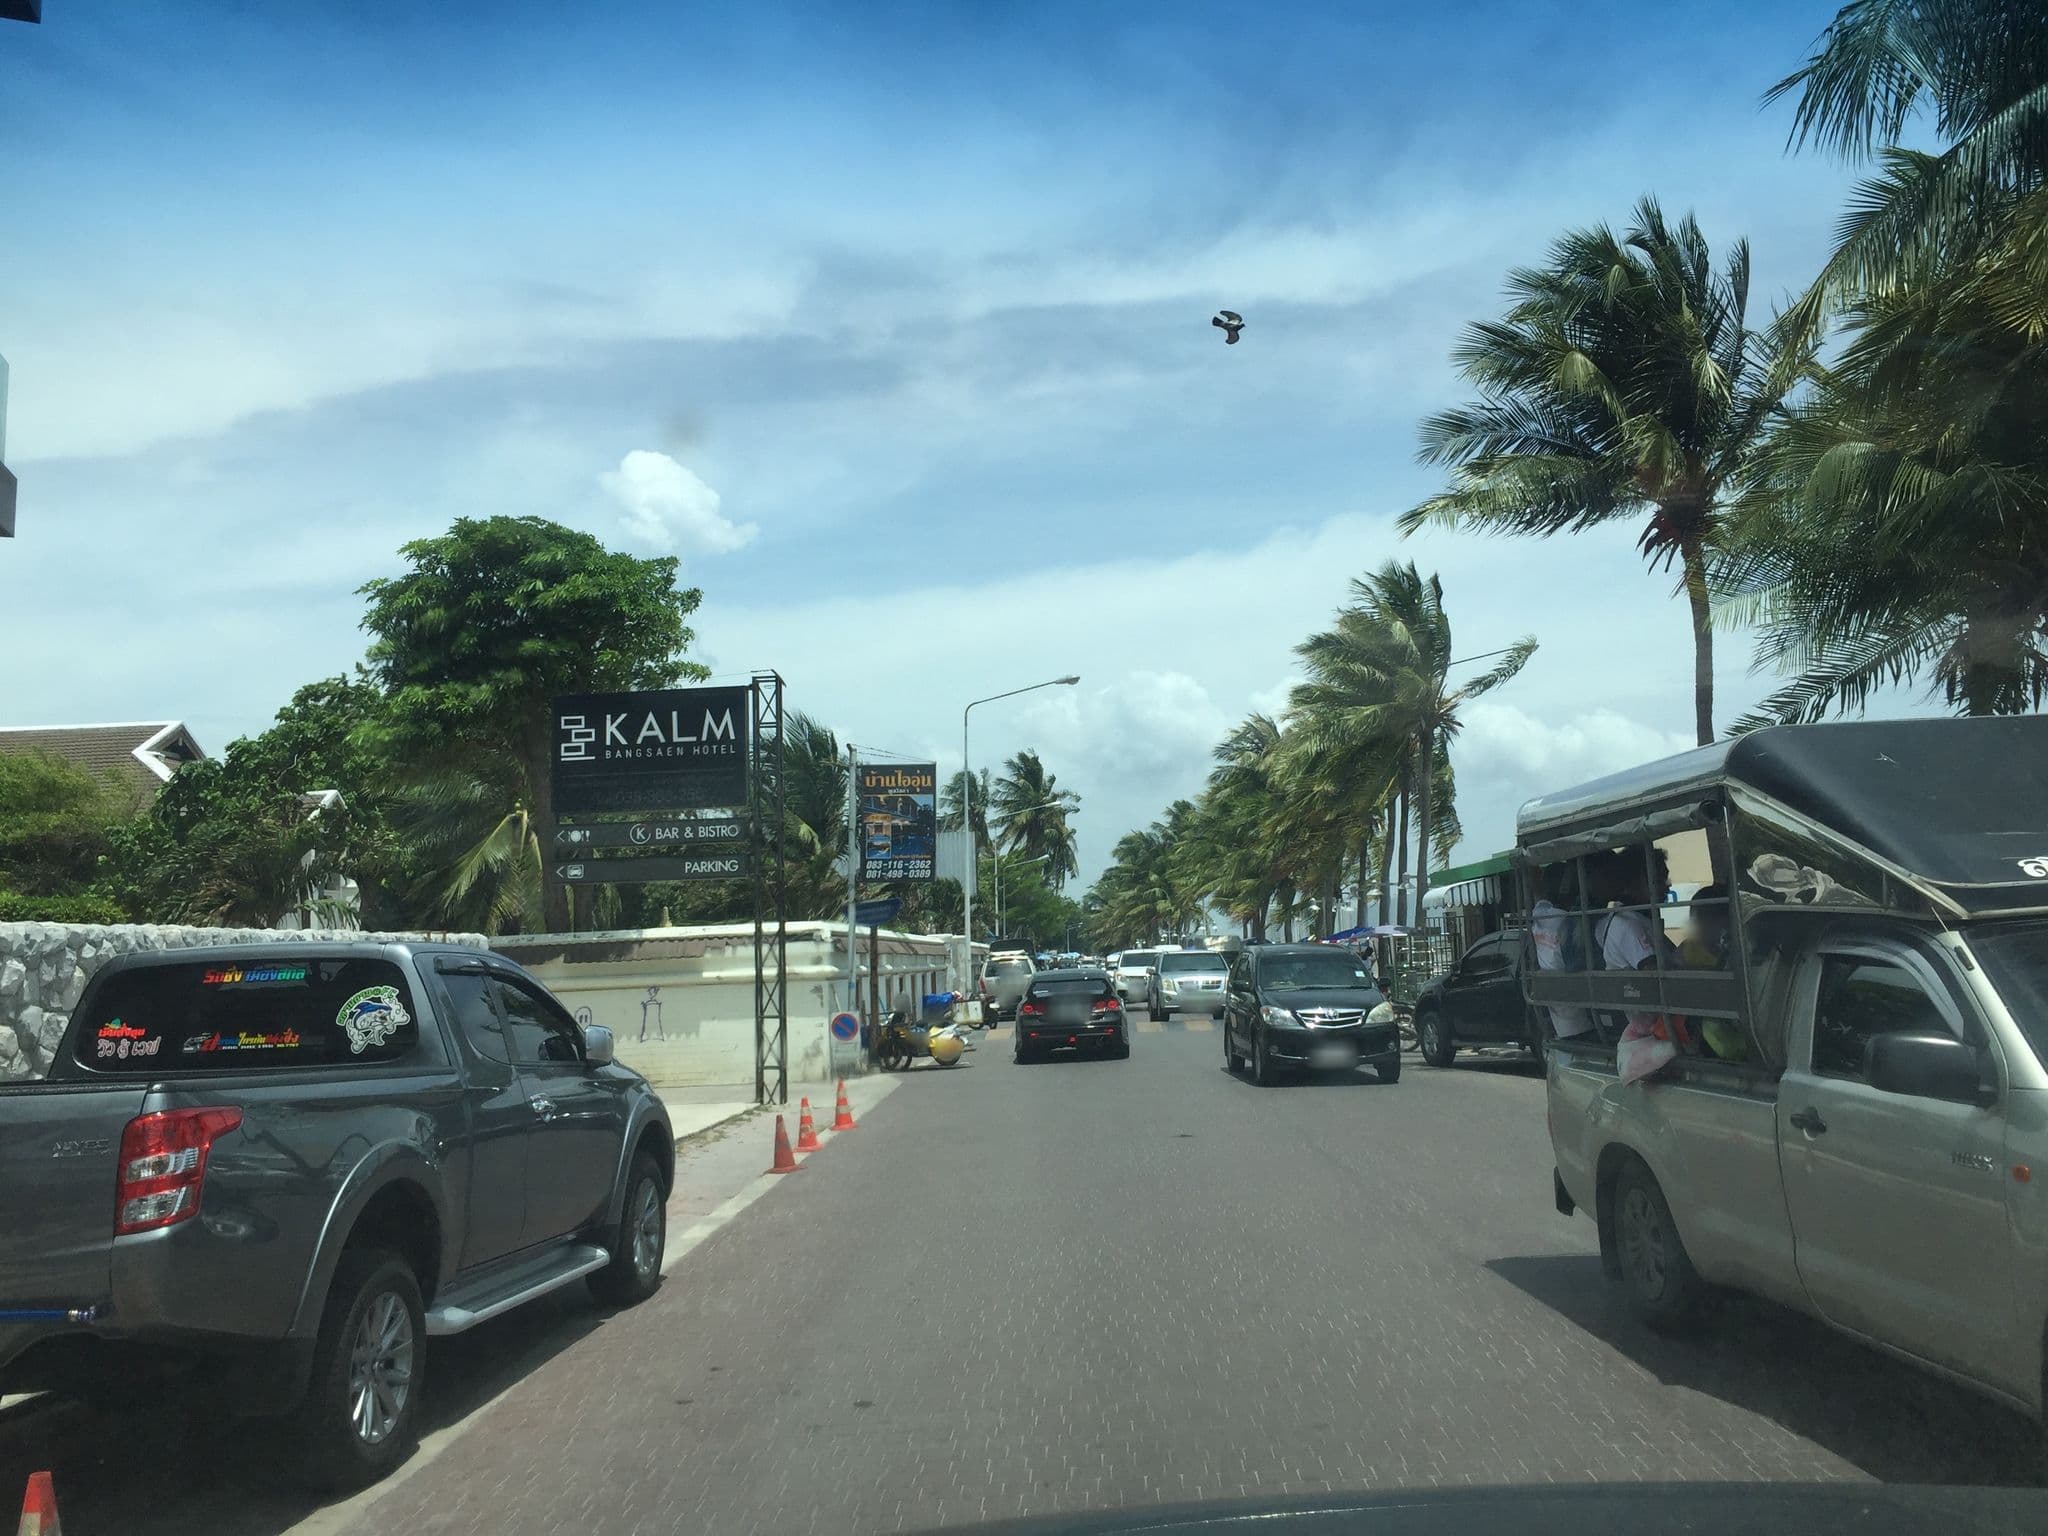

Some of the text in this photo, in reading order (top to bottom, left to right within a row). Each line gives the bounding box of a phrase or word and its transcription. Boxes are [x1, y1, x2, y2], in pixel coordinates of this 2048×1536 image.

[606, 707, 736, 746] KALM
[605, 744, 736, 759] BANGSAEN HOTEL
[864, 769, 932, 793] บ้านไออุ่น
[655, 827, 679, 840] BAR
[684, 827, 694, 839] &
[698, 824, 740, 838] BISTRO
[684, 859, 739, 873] PARKING
[866, 860, 931, 869] 083-116-2362
